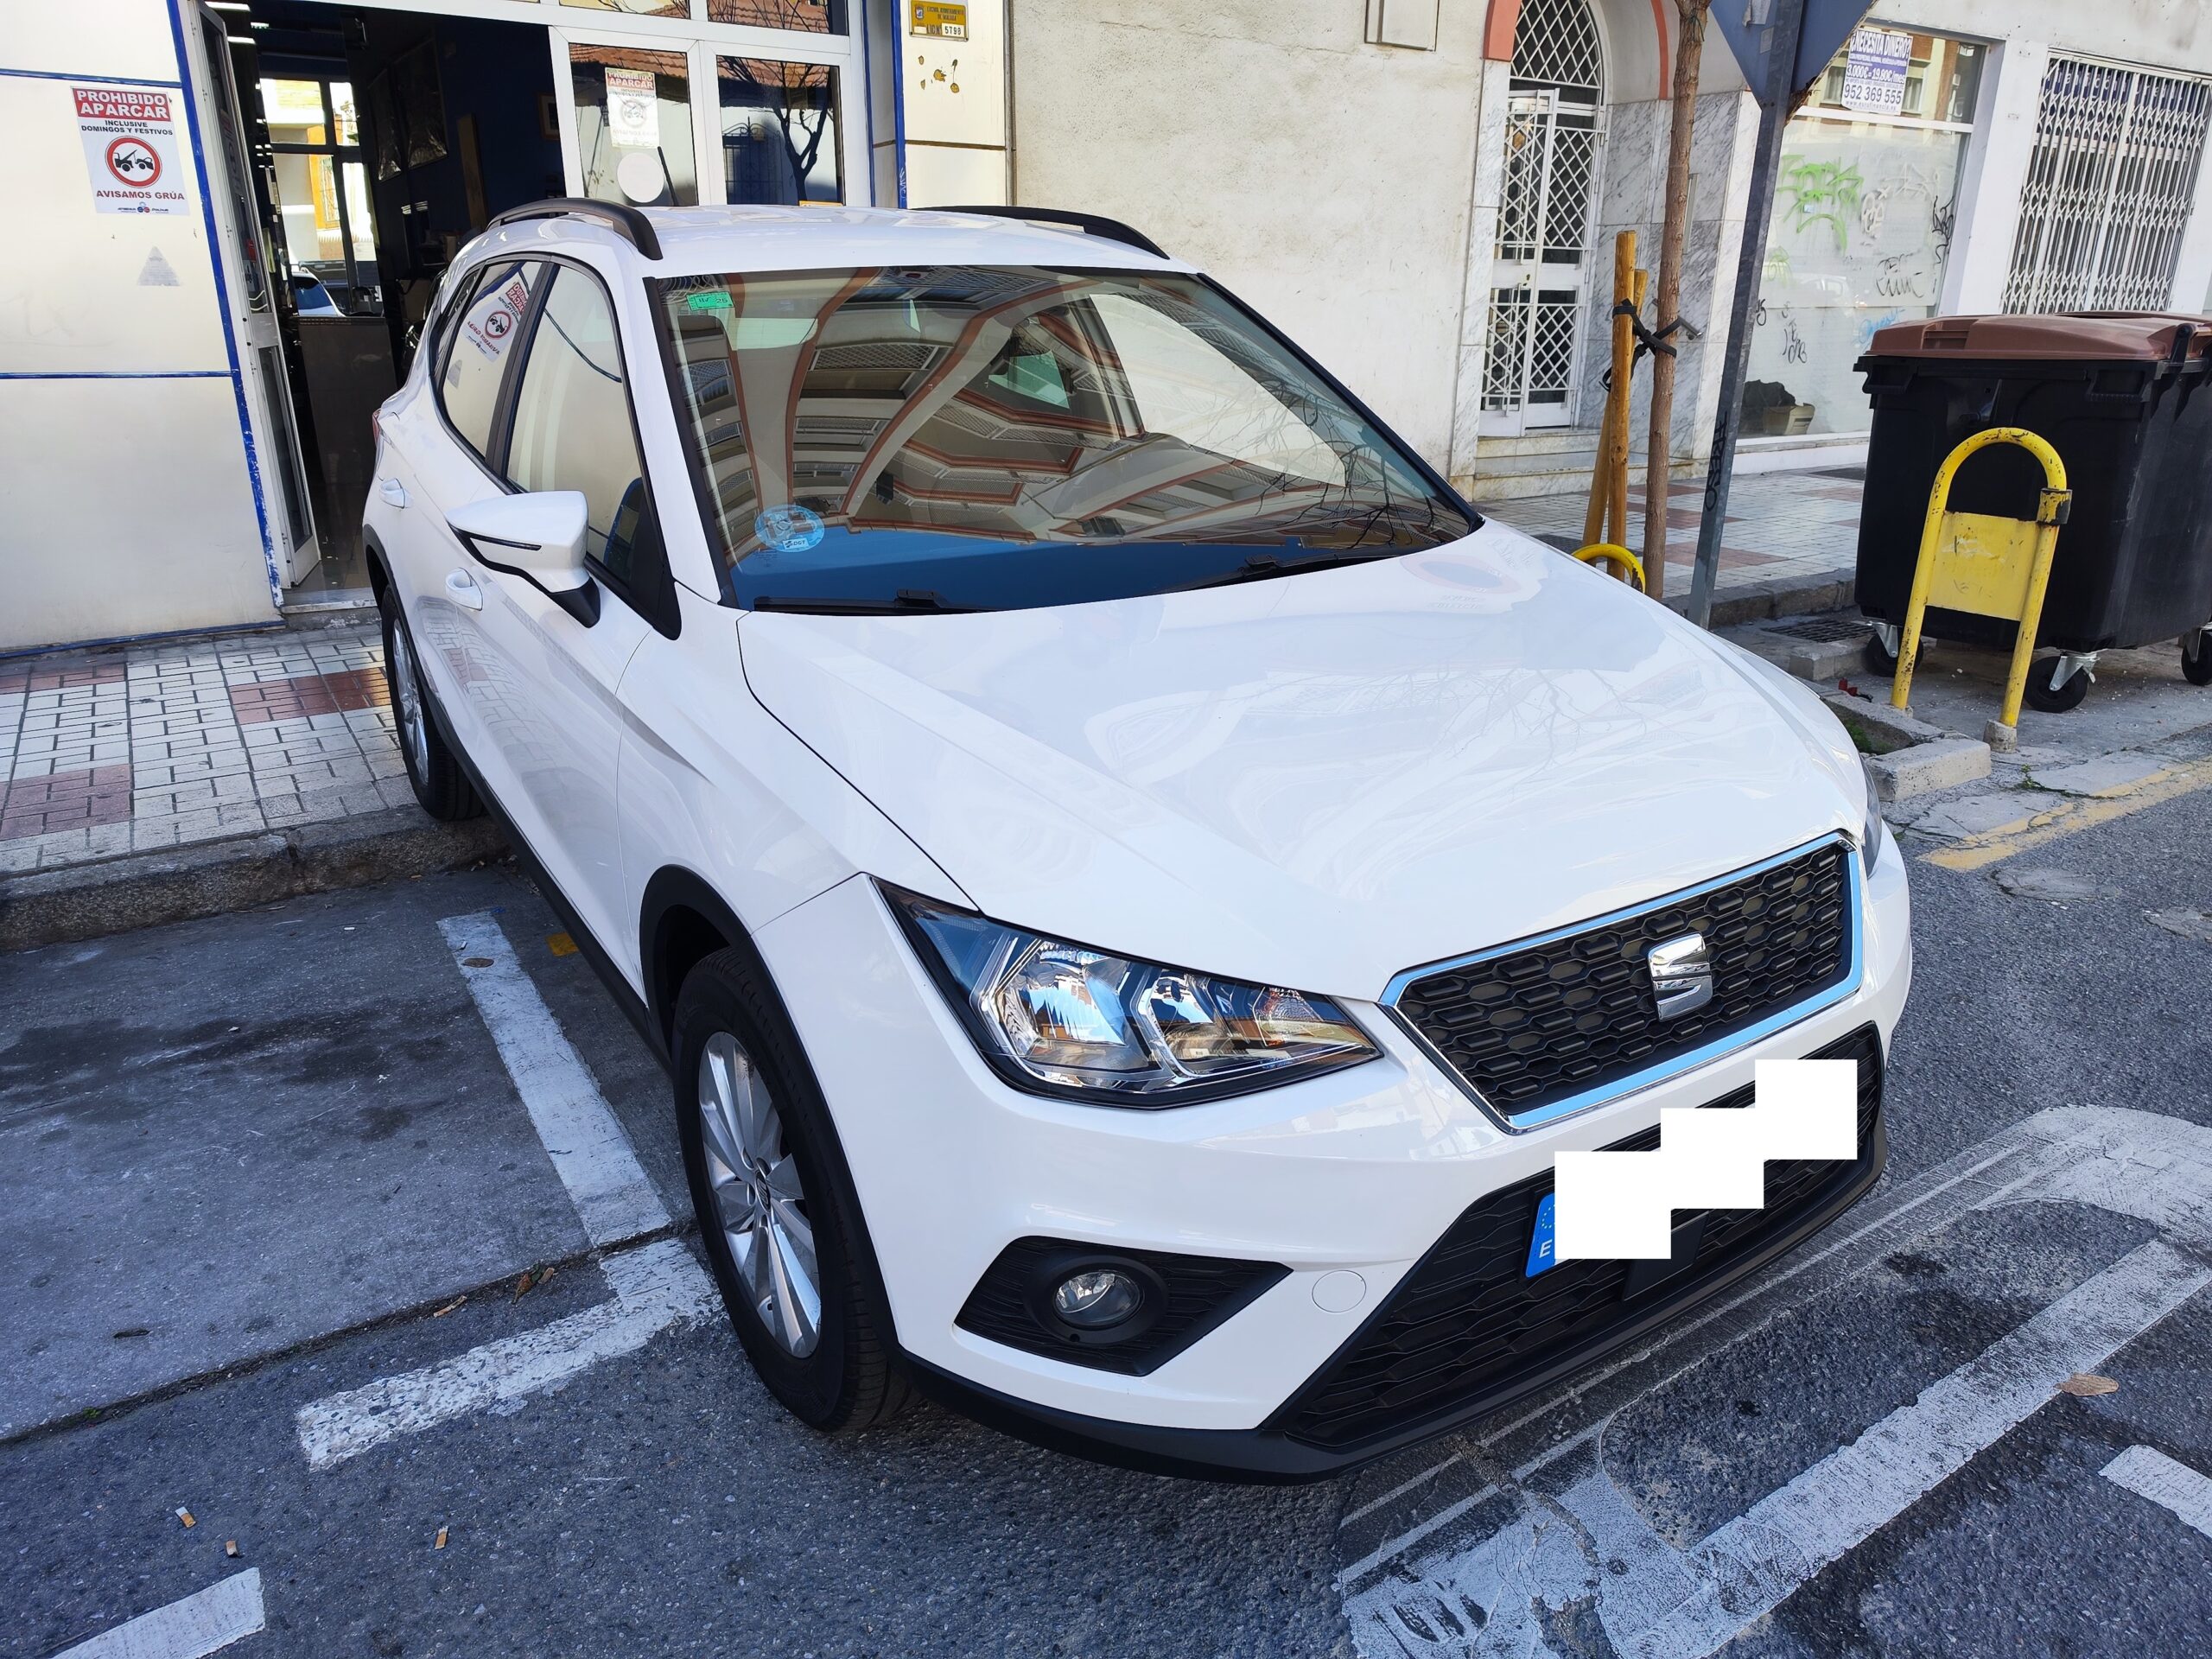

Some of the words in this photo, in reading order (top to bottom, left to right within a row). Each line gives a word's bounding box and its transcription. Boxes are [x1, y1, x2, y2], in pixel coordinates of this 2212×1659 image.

[1884, 35, 1912, 59] DINERO?
[608, 78, 654, 89] APARCAR
[77, 90, 165, 105] PROHIBIDO
[1844, 84, 1862, 100] 952
[1864, 86, 1882, 102] 369
[1885, 89, 1902, 105] 555
[80, 102, 168, 118] APARCAR
[96, 190, 152, 199] AVISAMOS
[155, 191, 185, 200] GRÚA
[1539, 1238, 1553, 1259] E
